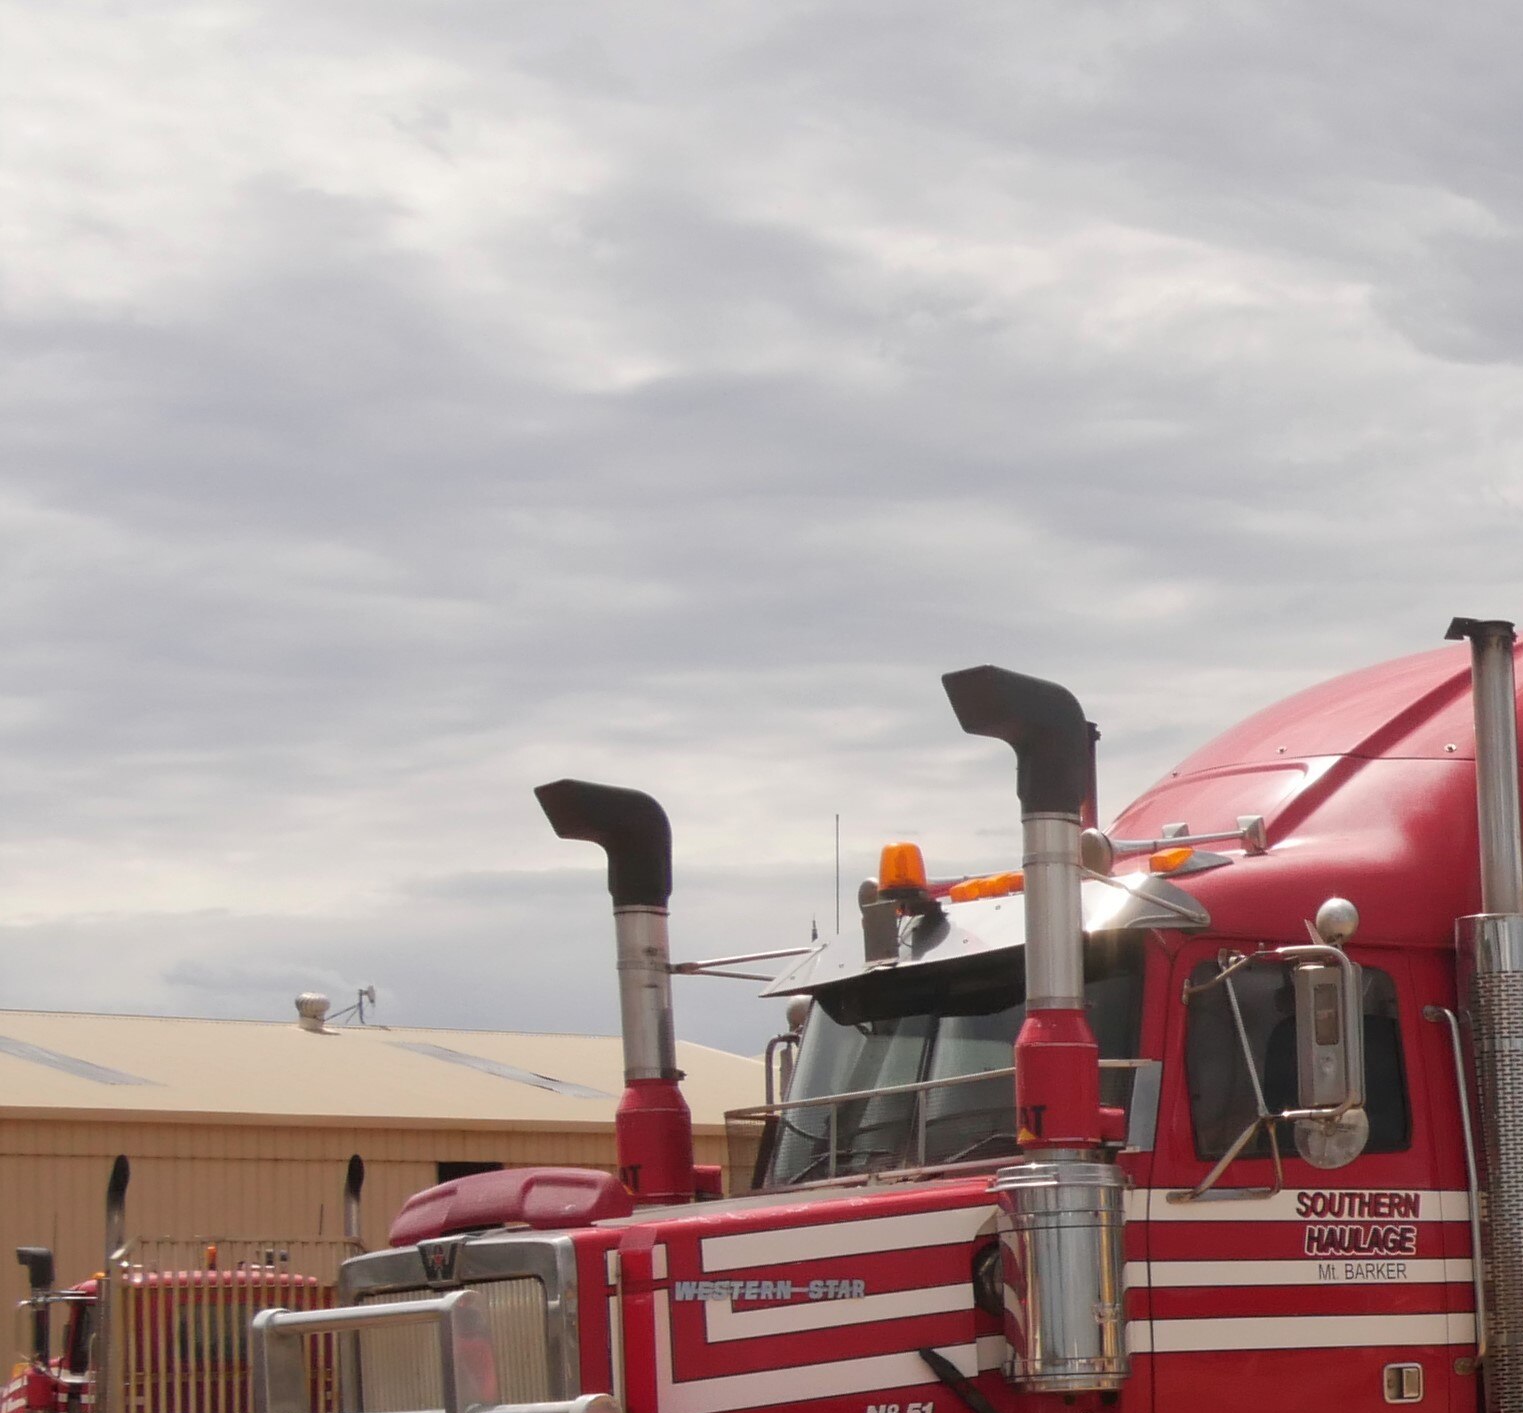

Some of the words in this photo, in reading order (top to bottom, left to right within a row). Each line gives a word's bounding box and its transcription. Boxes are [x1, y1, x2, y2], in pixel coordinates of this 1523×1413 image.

[1296, 1191, 1420, 1218] SOUTHERN
[1304, 1225, 1417, 1255] HAULAGE
[1345, 1263, 1407, 1279] BARKER
[675, 1280, 791, 1301] WESTERN
[808, 1279, 866, 1299] STAR
